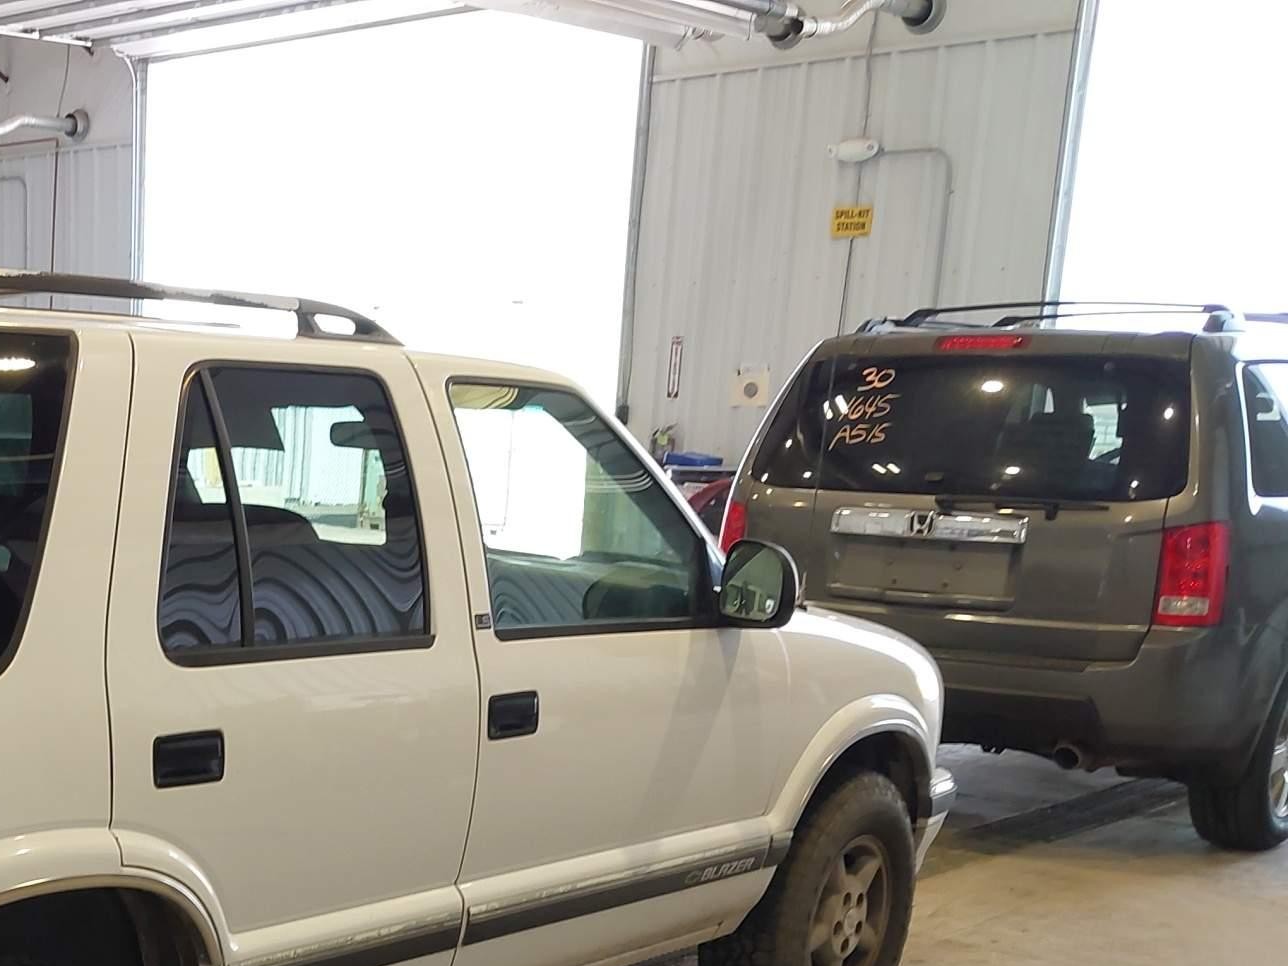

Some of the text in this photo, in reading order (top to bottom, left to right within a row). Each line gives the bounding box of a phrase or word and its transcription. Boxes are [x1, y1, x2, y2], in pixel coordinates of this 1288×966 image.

[835, 208, 871, 220] SPILL-KIT
[836, 221, 867, 232] STATION
[857, 366, 896, 391] 30
[700, 857, 756, 882] BLAZER
